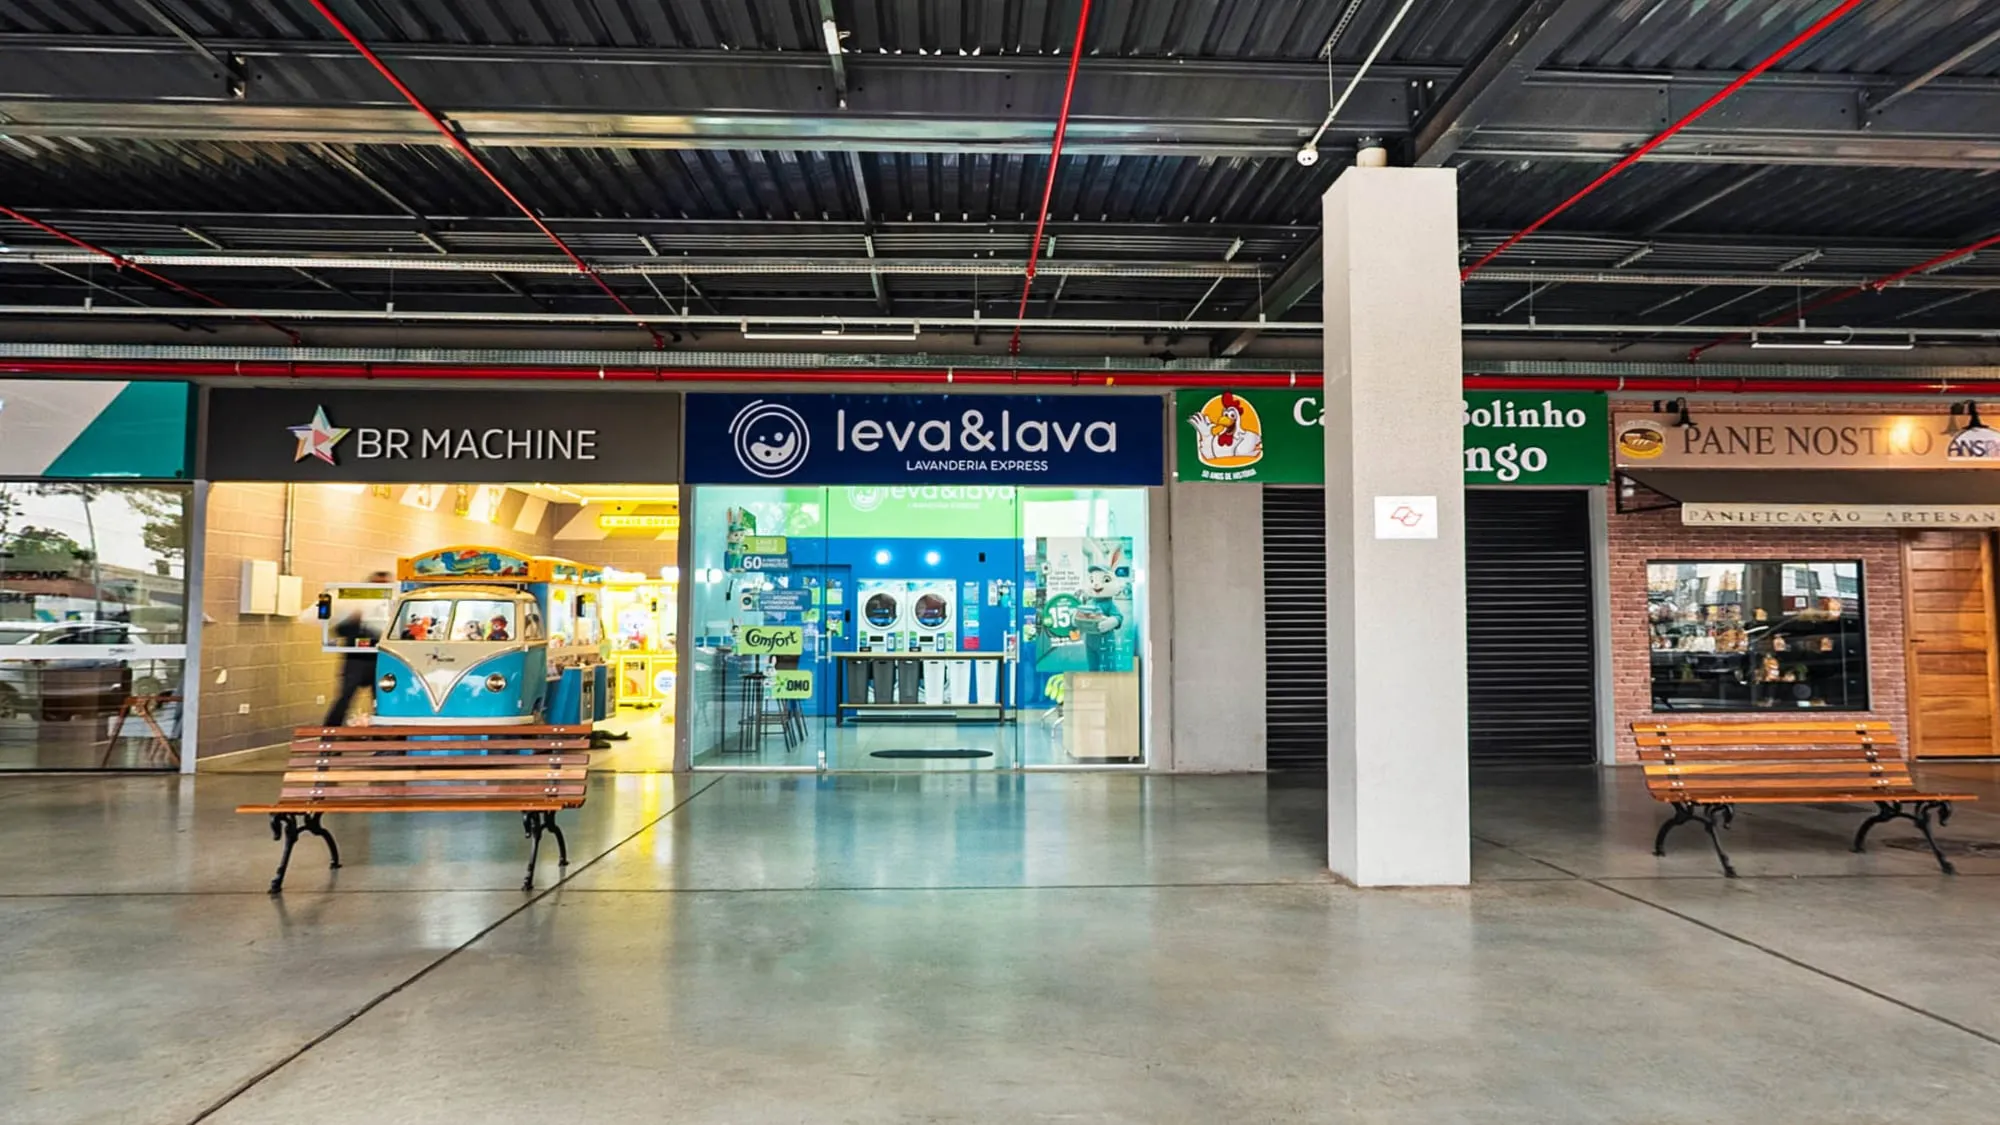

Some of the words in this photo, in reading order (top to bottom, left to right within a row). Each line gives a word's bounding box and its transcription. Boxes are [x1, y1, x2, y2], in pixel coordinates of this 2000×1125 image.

[836, 408, 1117, 453] leva&lava
[1683, 426, 1775, 454] PANE
[356, 428, 410, 459] BR
[421, 428, 597, 460] MACHINE
[906, 459, 988, 472] LAVANDERIA
[990, 459, 1049, 473] EXPRESS
[1689, 509, 1862, 524] PANIFICAÇÃO
[1883, 512, 1996, 522] ARTESAN
[743, 556, 762, 569] 60
[745, 628, 798, 653] Comfort
[786, 680, 810, 692] OMO
